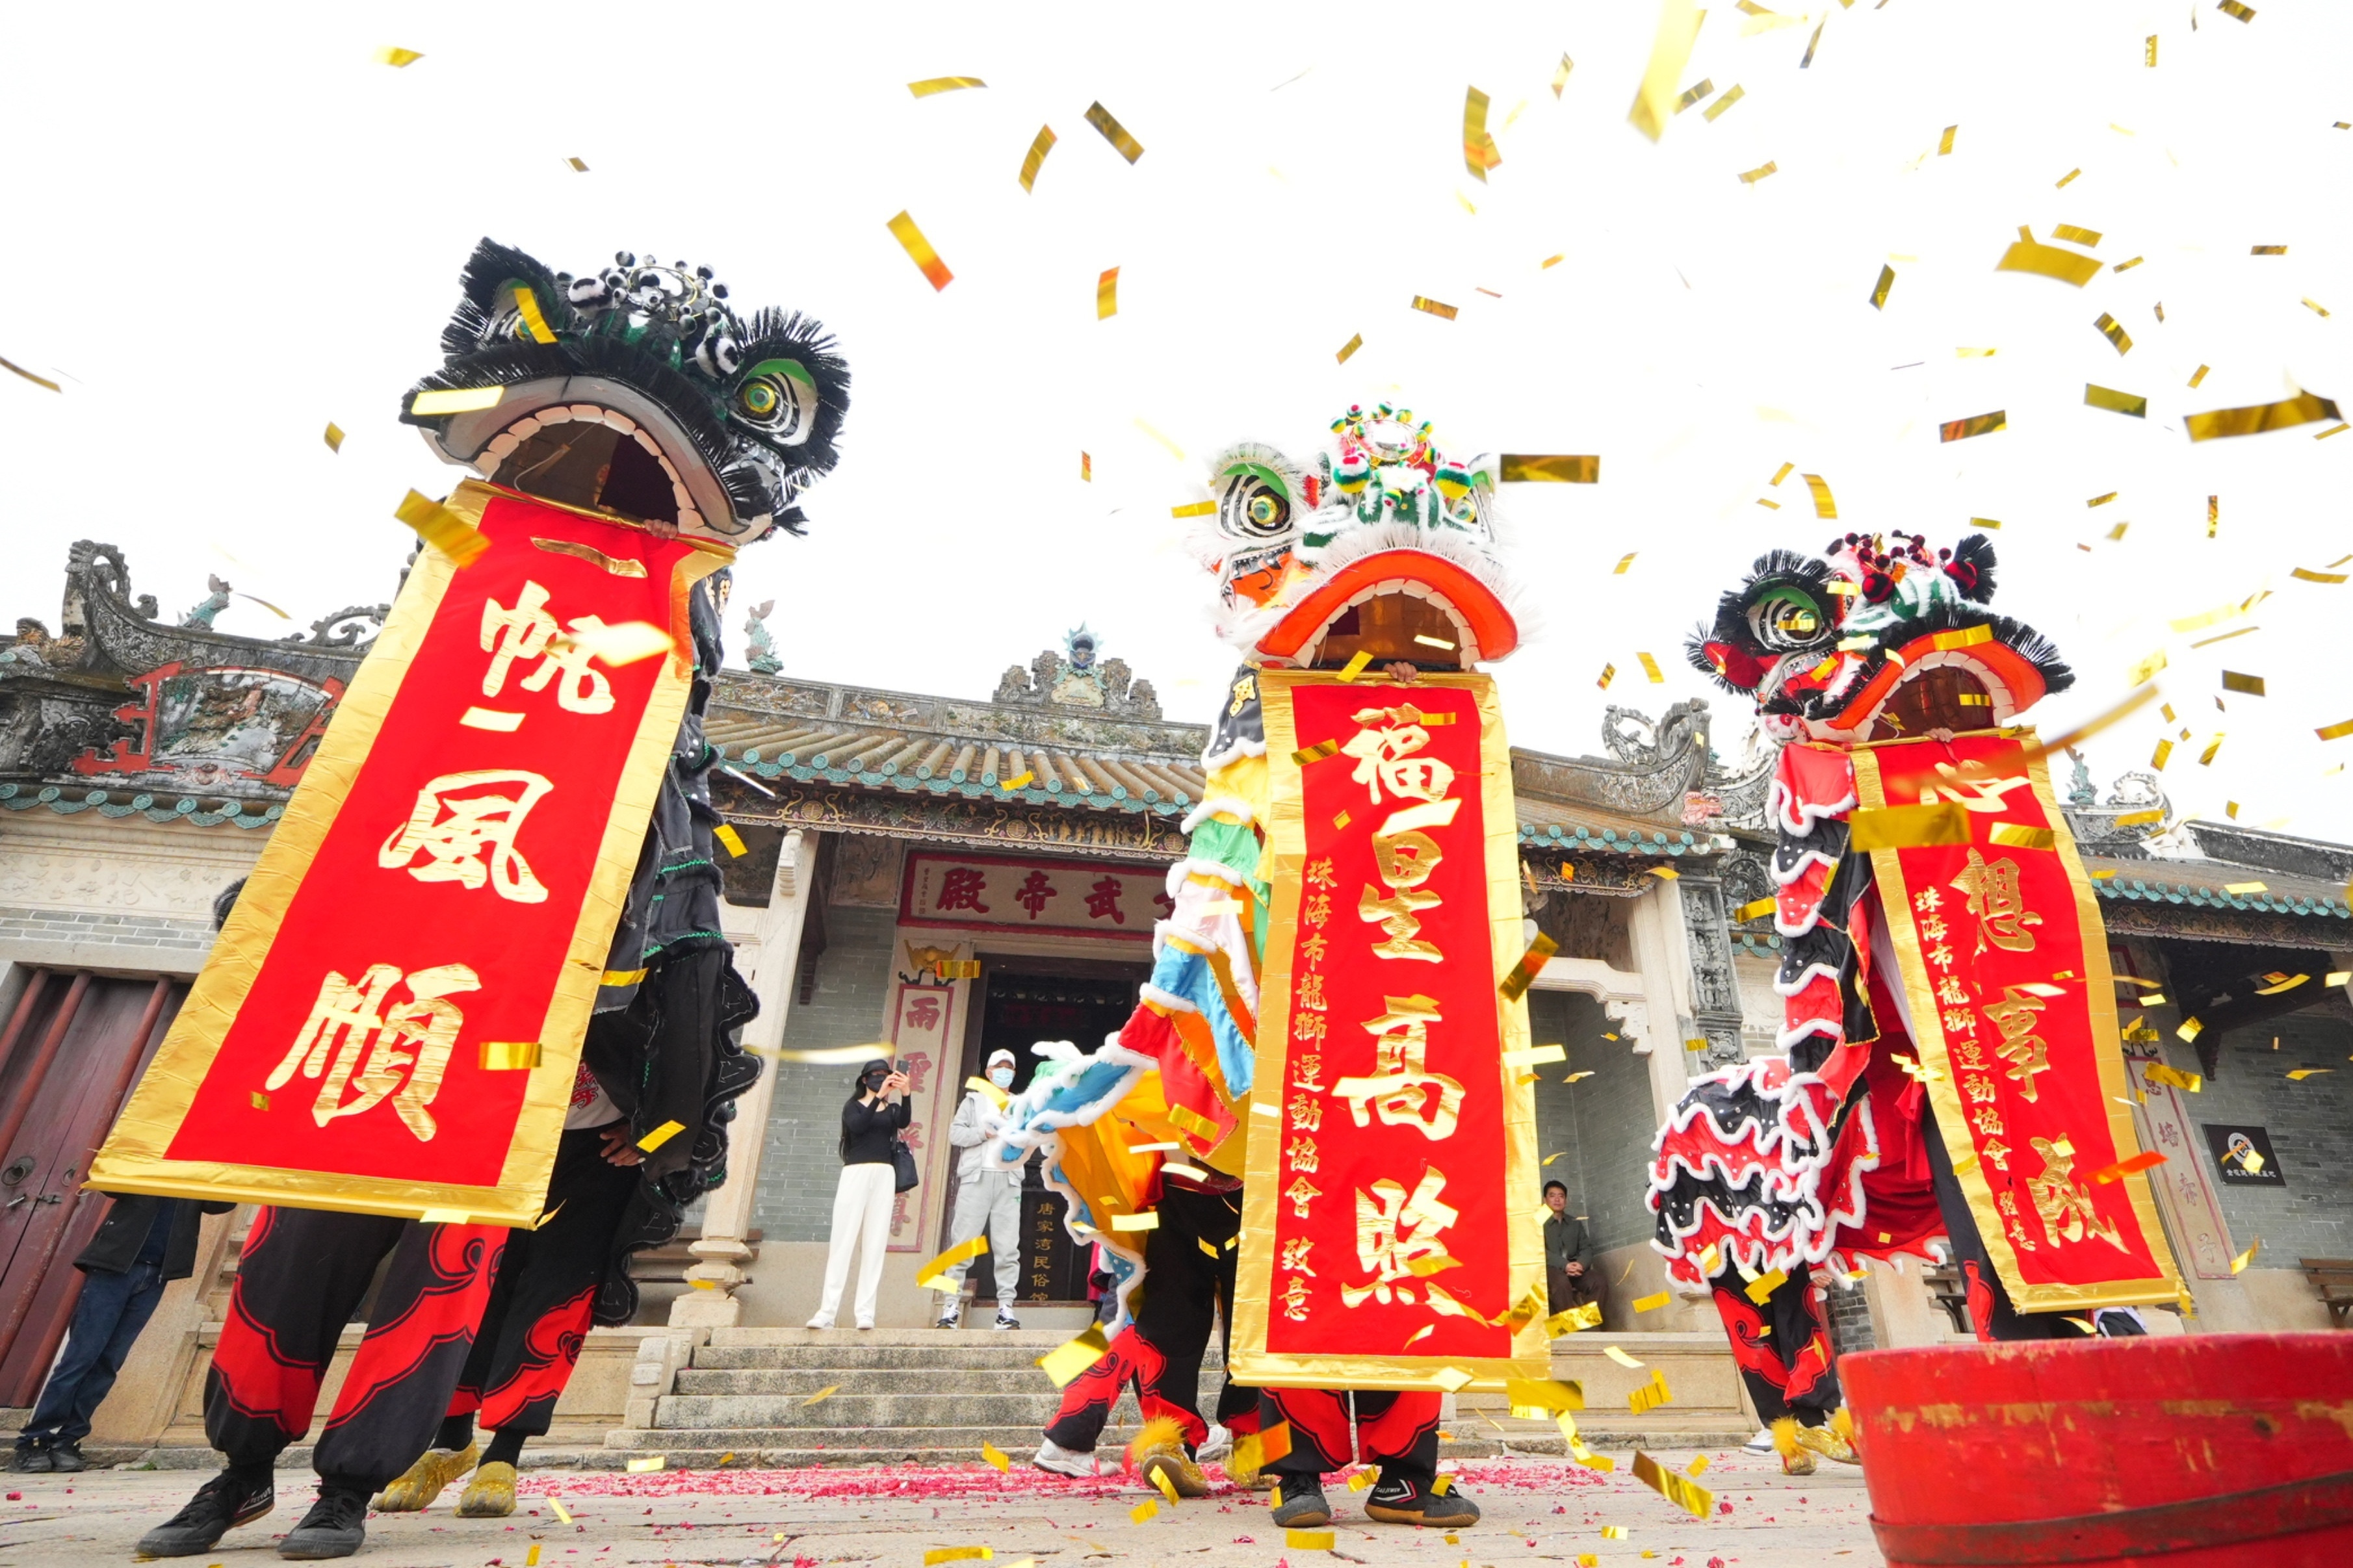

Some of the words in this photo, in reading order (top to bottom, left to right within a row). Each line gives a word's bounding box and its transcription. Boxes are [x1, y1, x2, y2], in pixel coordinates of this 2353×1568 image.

[265, 535, 647, 1142] 一帆風順
[937, 868, 1176, 924] 武帝殿
[1340, 702, 1466, 1316] 福星高照
